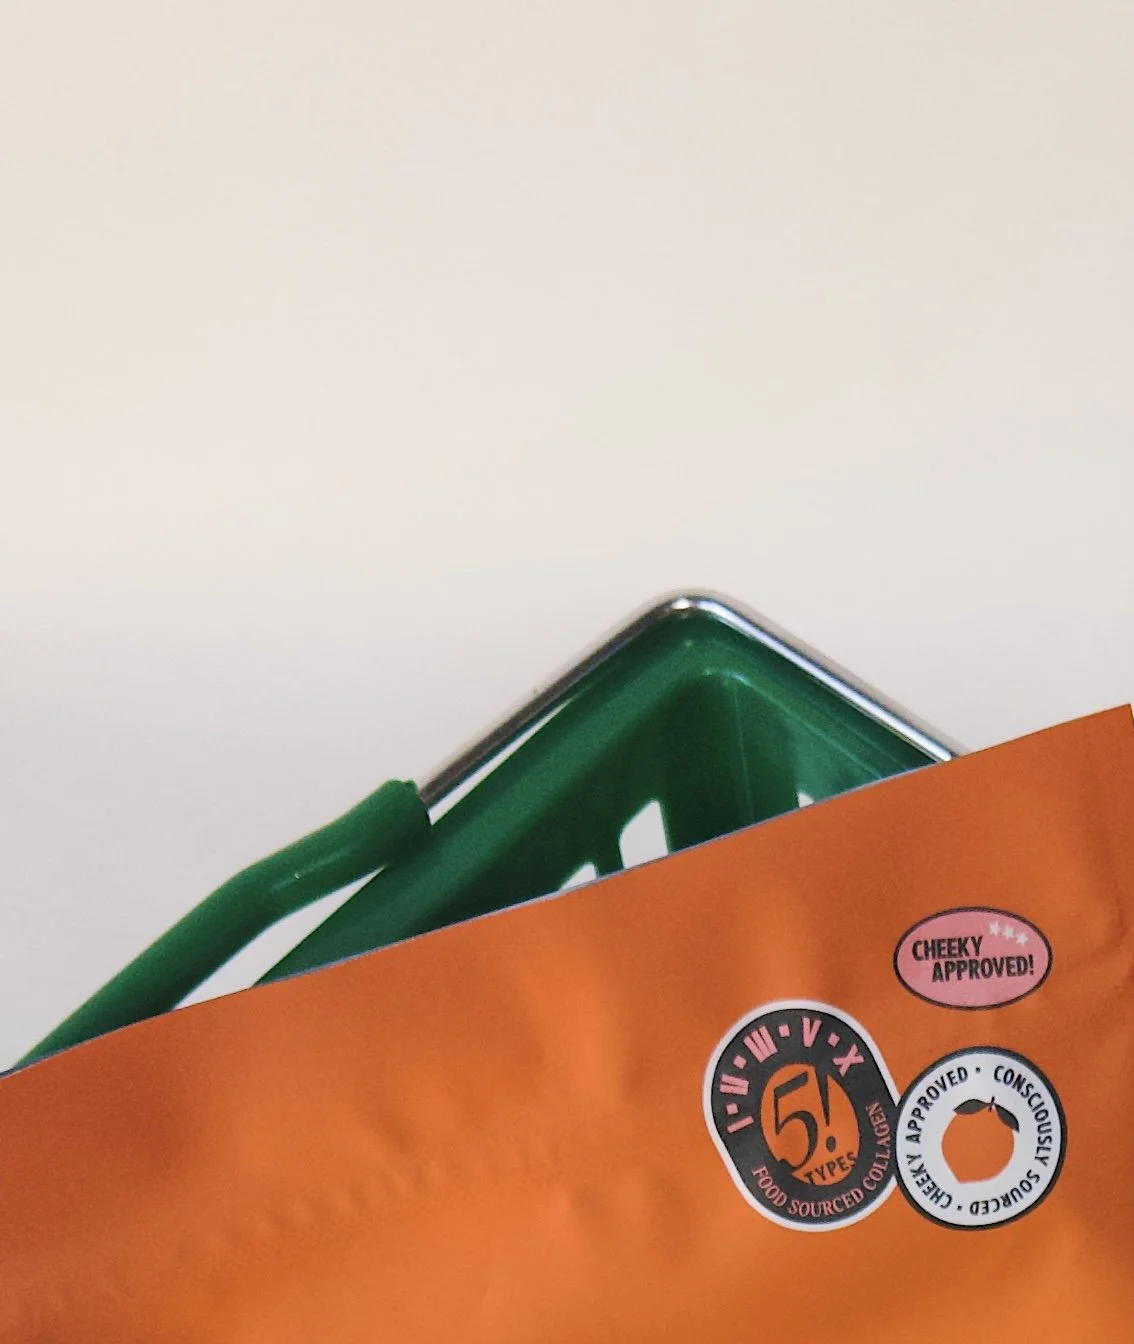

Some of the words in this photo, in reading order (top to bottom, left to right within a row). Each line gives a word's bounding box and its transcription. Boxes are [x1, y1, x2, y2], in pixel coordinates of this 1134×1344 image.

[912, 936, 982, 961] CHEEKY
[931, 955, 1035, 984] APPROVED!
[905, 1066, 968, 1144] APPROVED
[994, 1065, 1052, 1167] CONSCIOUSLY
[751, 1166, 788, 1208] FOOD
[788, 1190, 864, 1217] SOURCED
[862, 1102, 891, 1191] COLLAGEN
[804, 1151, 858, 1184] TYPES
[906, 1154, 953, 1210] CHEEKY
[969, 1169, 1041, 1216] SOURCED
